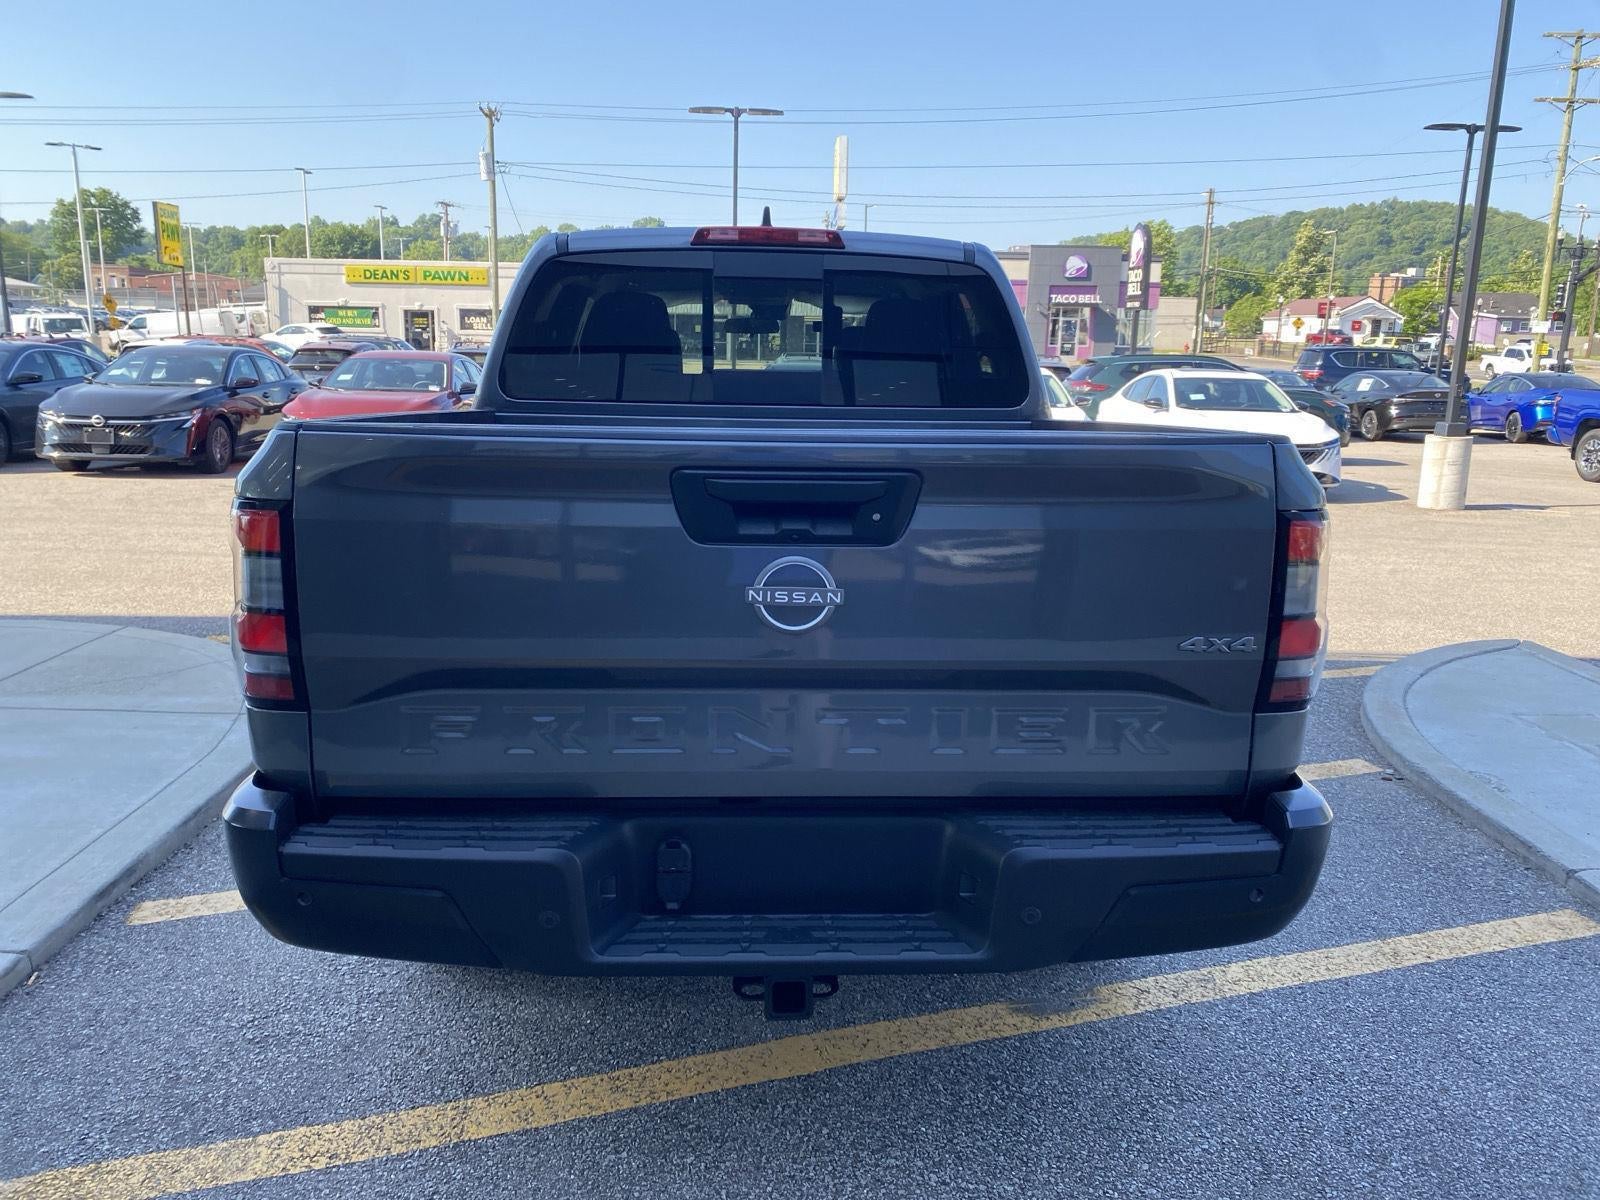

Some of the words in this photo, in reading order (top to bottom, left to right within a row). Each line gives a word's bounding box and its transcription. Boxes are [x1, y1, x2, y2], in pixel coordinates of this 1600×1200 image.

[161, 220, 180, 242] PAWN
[363, 269, 410, 281] DEAN'S
[422, 270, 469, 282] PAWN
[1050, 294, 1077, 303] TACO
[1078, 294, 1103, 303] BELL
[326, 317, 342, 325] GOLD
[343, 317, 354, 325] AND
[748, 590, 841, 603] NISSAN
[400, 706, 1170, 756] FRONTIER
